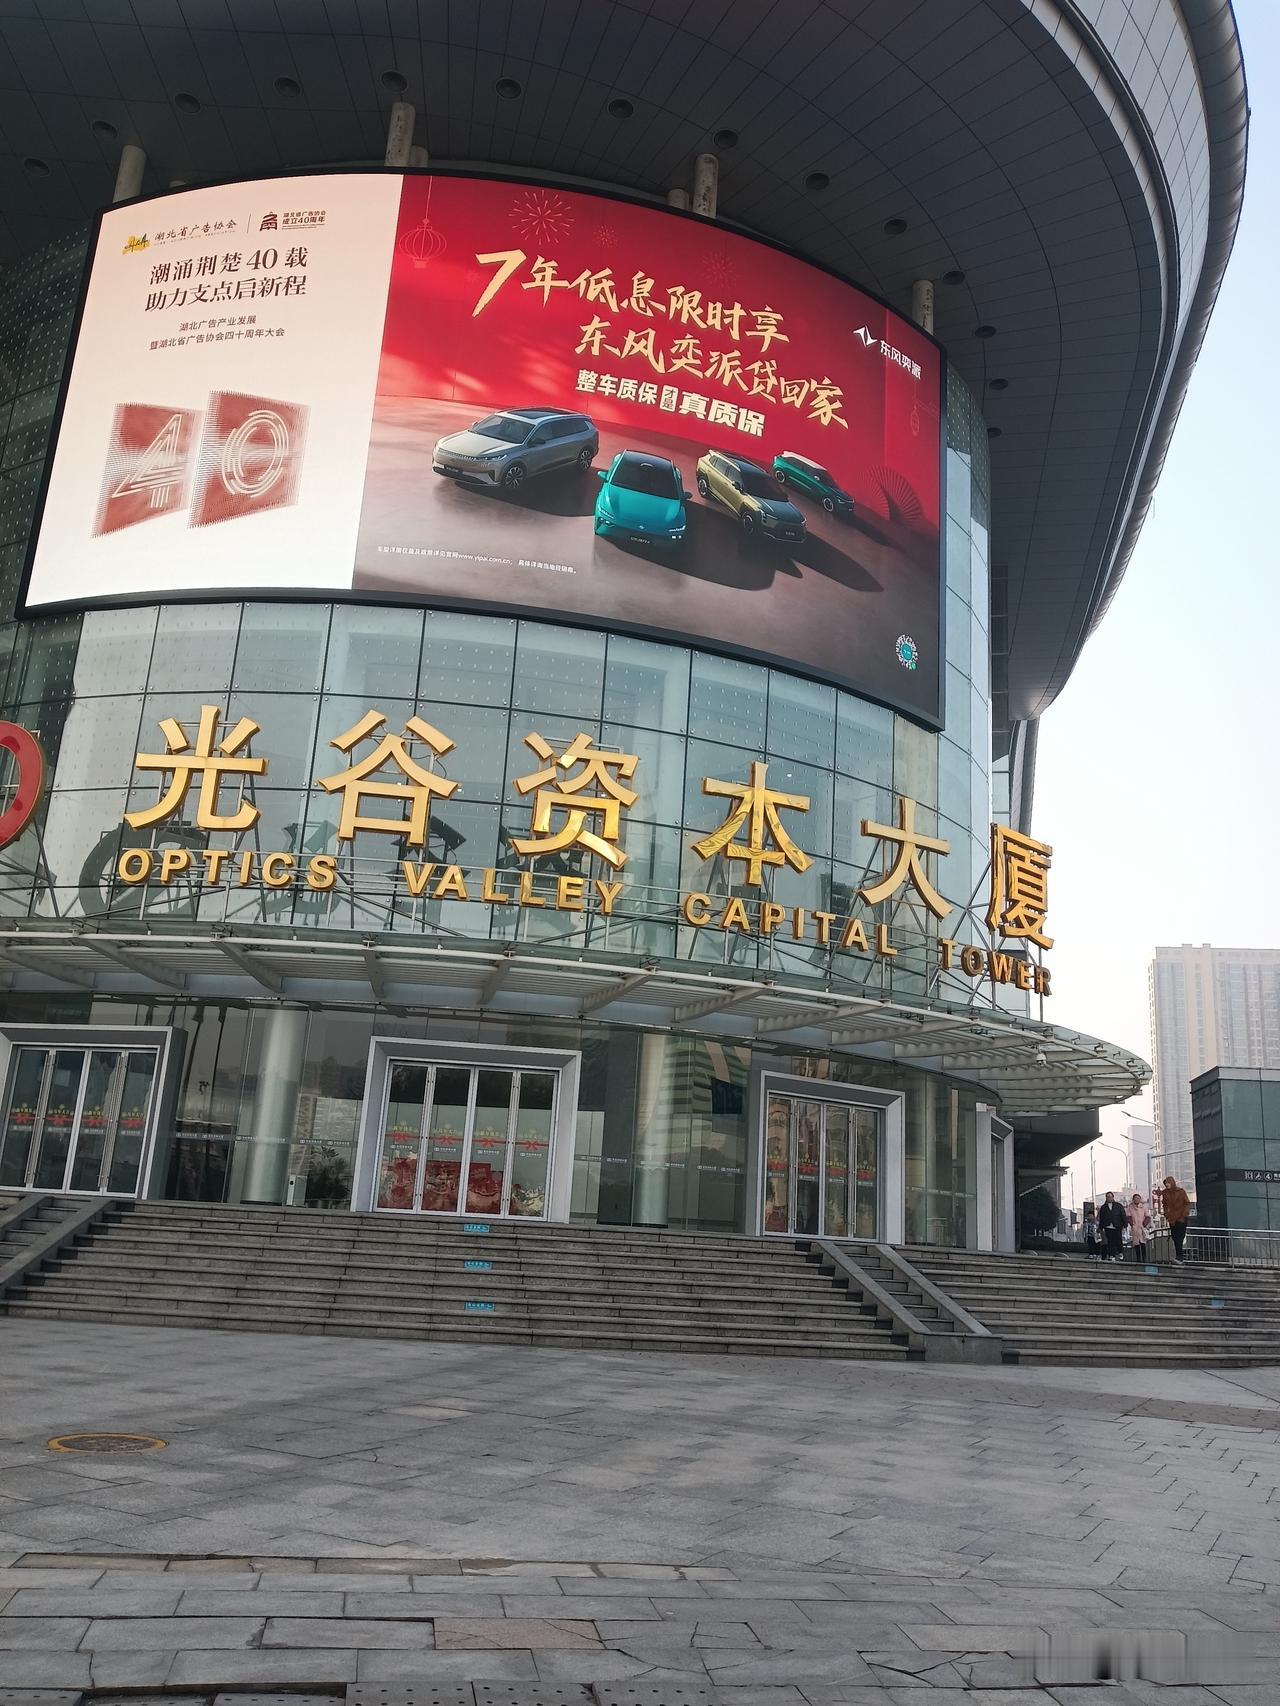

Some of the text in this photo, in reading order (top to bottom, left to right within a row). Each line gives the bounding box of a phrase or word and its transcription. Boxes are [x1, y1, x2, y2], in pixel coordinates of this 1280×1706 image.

[145, 275, 307, 312] 助力支点启新程
[149, 327, 285, 350] 暨湖北省广告协会四十周年大会
[178, 315, 257, 332] 湖北广告产业发展
[472, 249, 790, 353] 7年低息限时享
[574, 314, 849, 429] 东风奕派贷回家
[123, 703, 1054, 951] 光谷资本大厦
[118, 847, 1053, 997] OPTICS VALLEY CAPITAL TOWER
